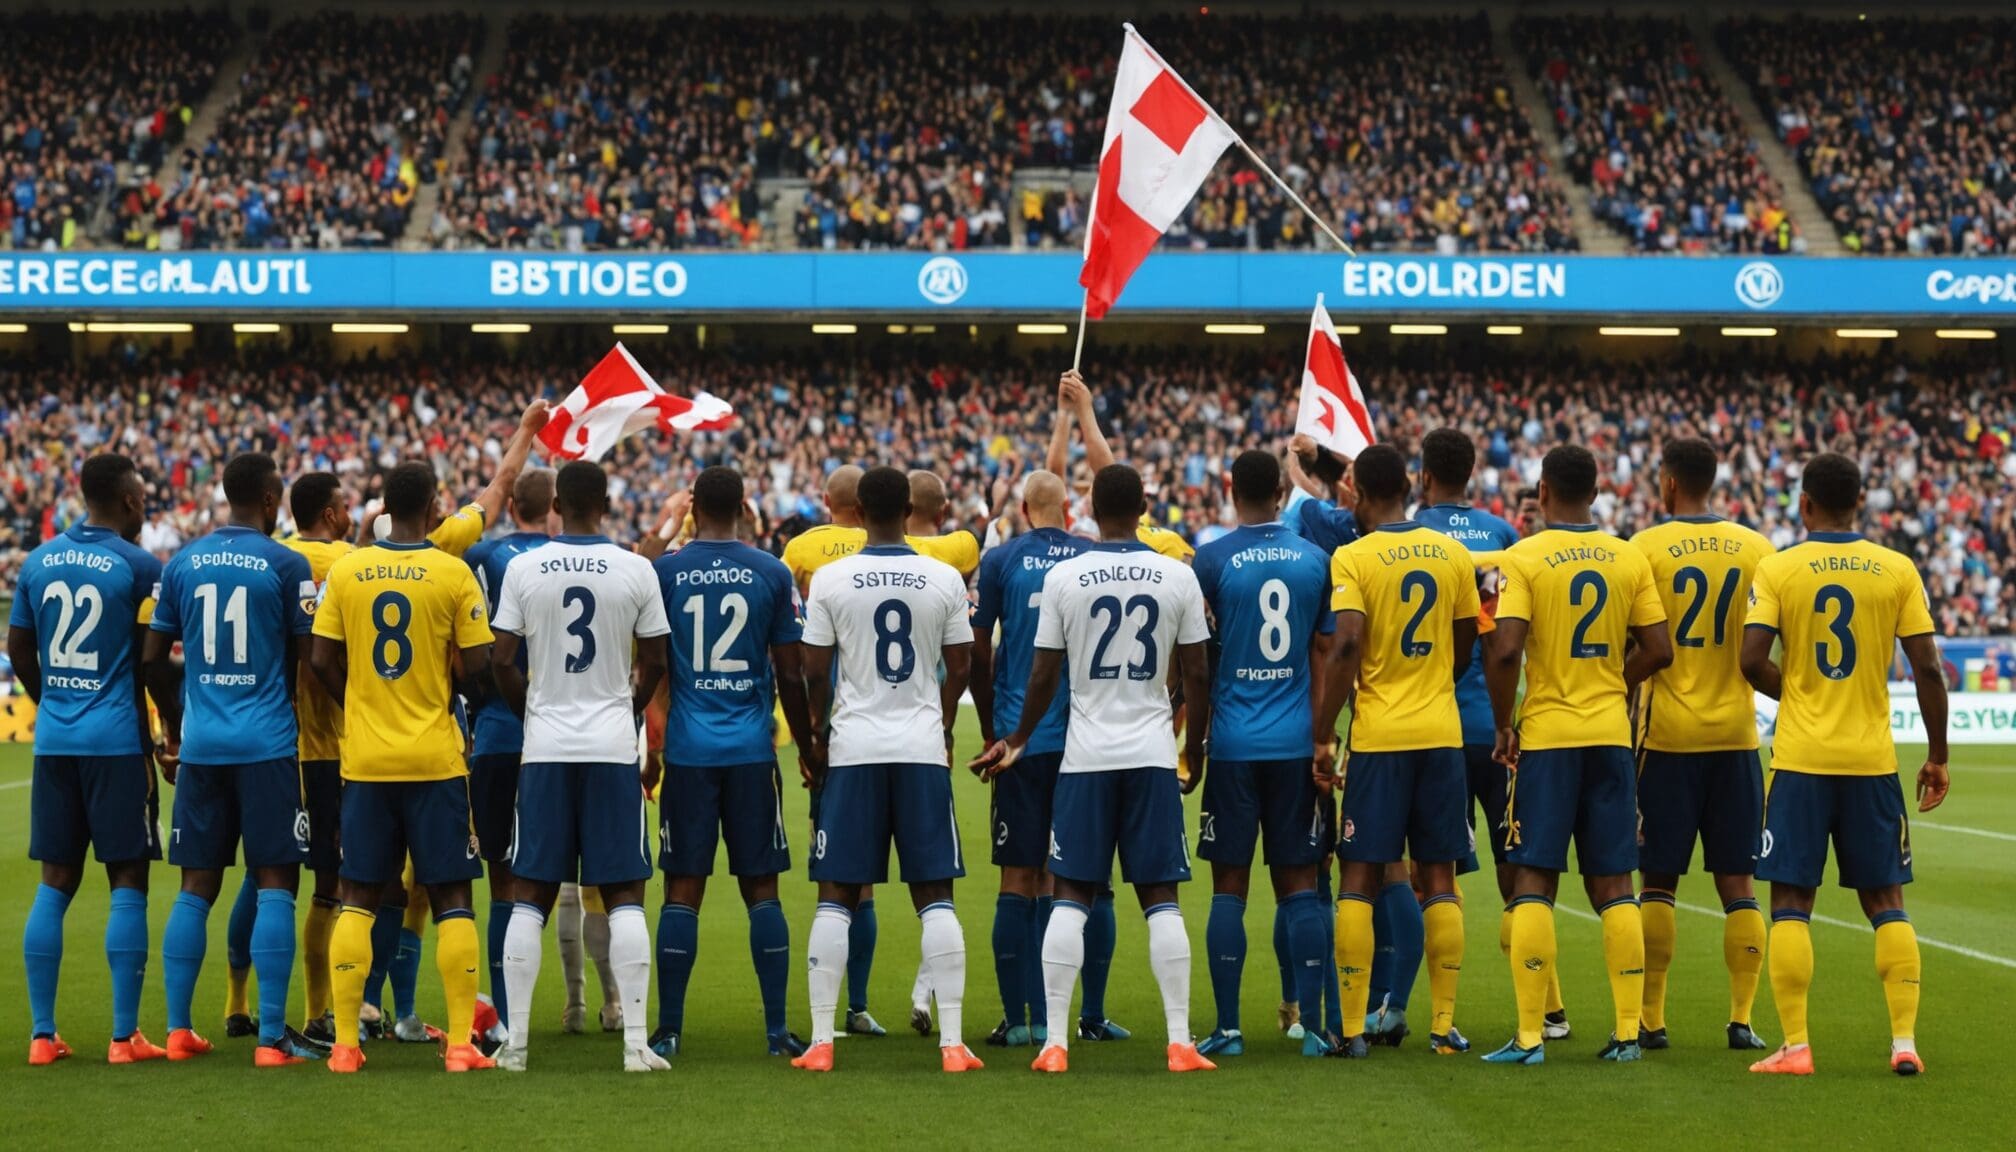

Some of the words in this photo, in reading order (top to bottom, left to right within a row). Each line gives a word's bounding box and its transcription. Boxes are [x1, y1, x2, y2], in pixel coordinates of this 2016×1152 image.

[42, 580, 103, 671] 22
[194, 583, 247, 665] 11
[372, 590, 412, 680] 8
[562, 586, 596, 673] 3
[683, 592, 749, 672] 12
[873, 598, 915, 683] 8
[1090, 594, 1159, 680] 23
[1259, 578, 1290, 662] 8
[1401, 569, 1438, 658] 2
[1569, 569, 1608, 659] 2
[1673, 566, 1741, 648] 21
[1814, 583, 1856, 681] 3
